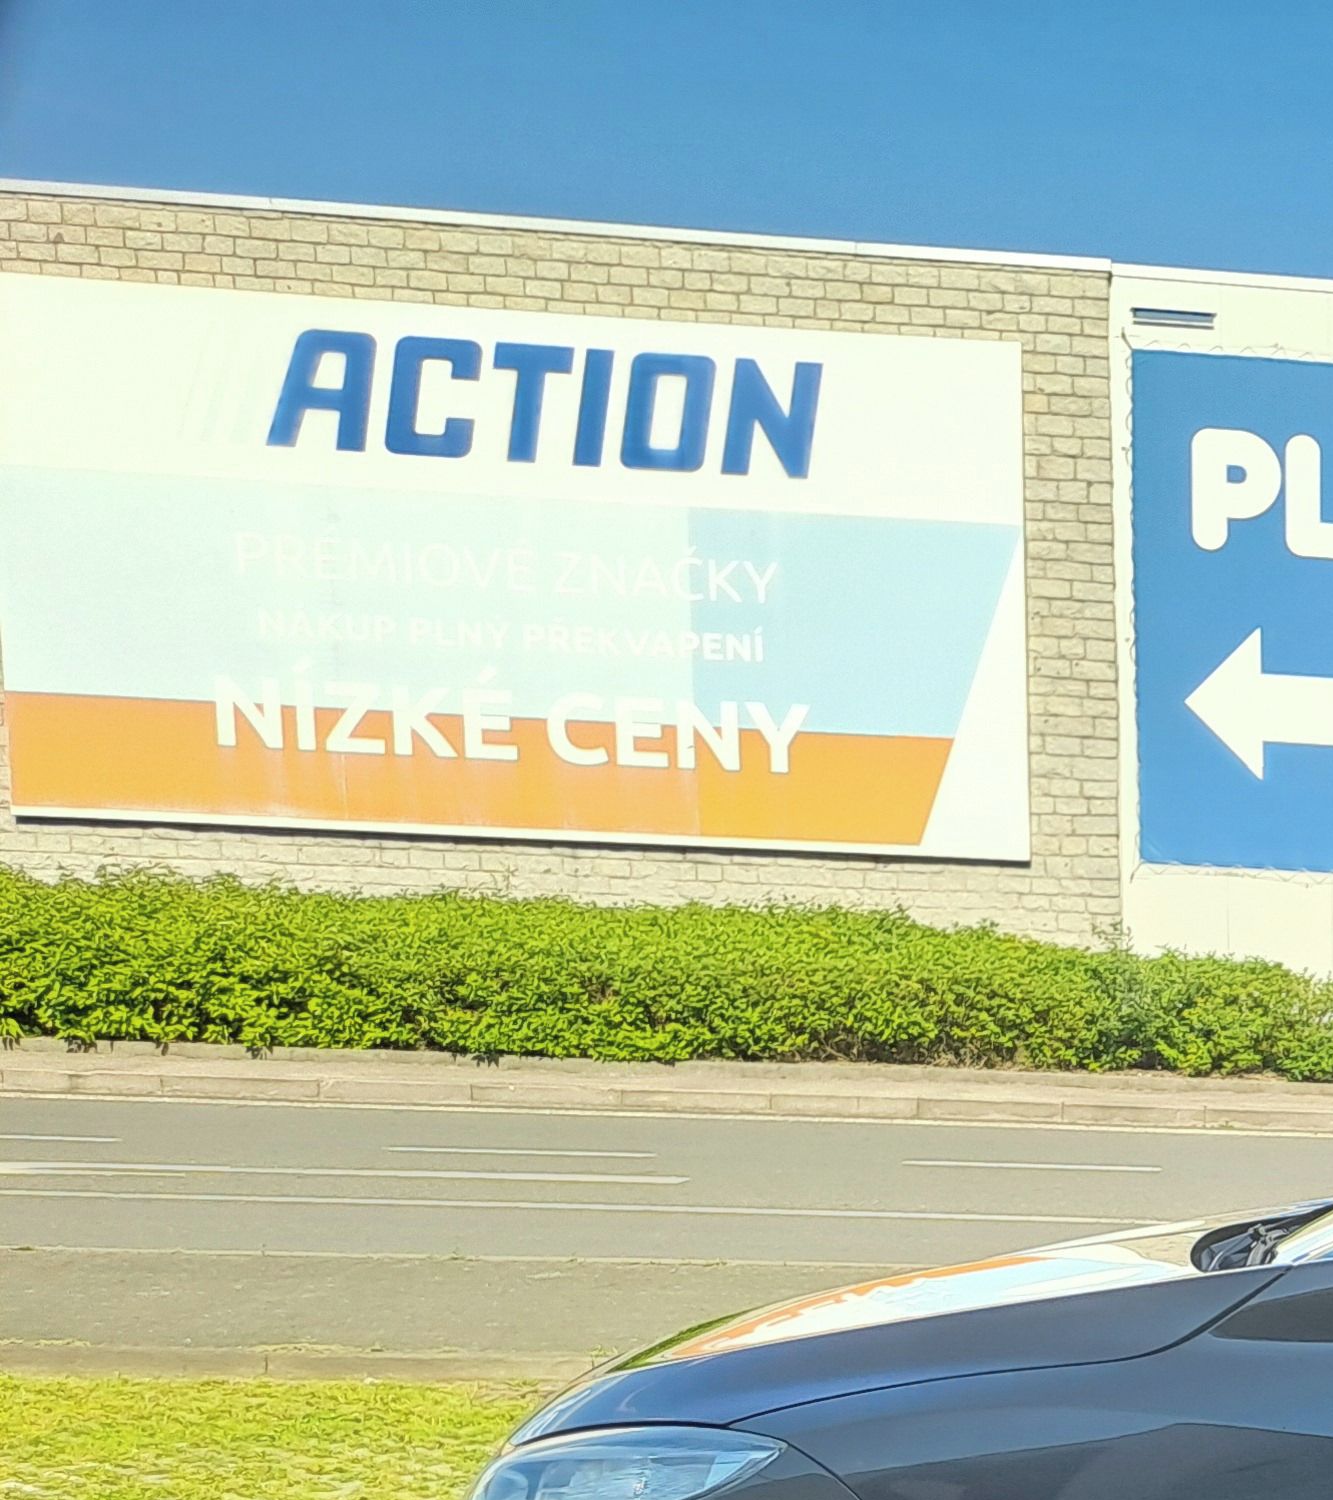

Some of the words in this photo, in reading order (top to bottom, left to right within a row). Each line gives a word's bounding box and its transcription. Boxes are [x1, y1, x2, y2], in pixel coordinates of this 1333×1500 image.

[266, 328, 823, 479] ACTION
[553, 545, 780, 604] ZNAČKY
[215, 657, 519, 761] NÍZKÉ
[546, 693, 811, 774] CENY
